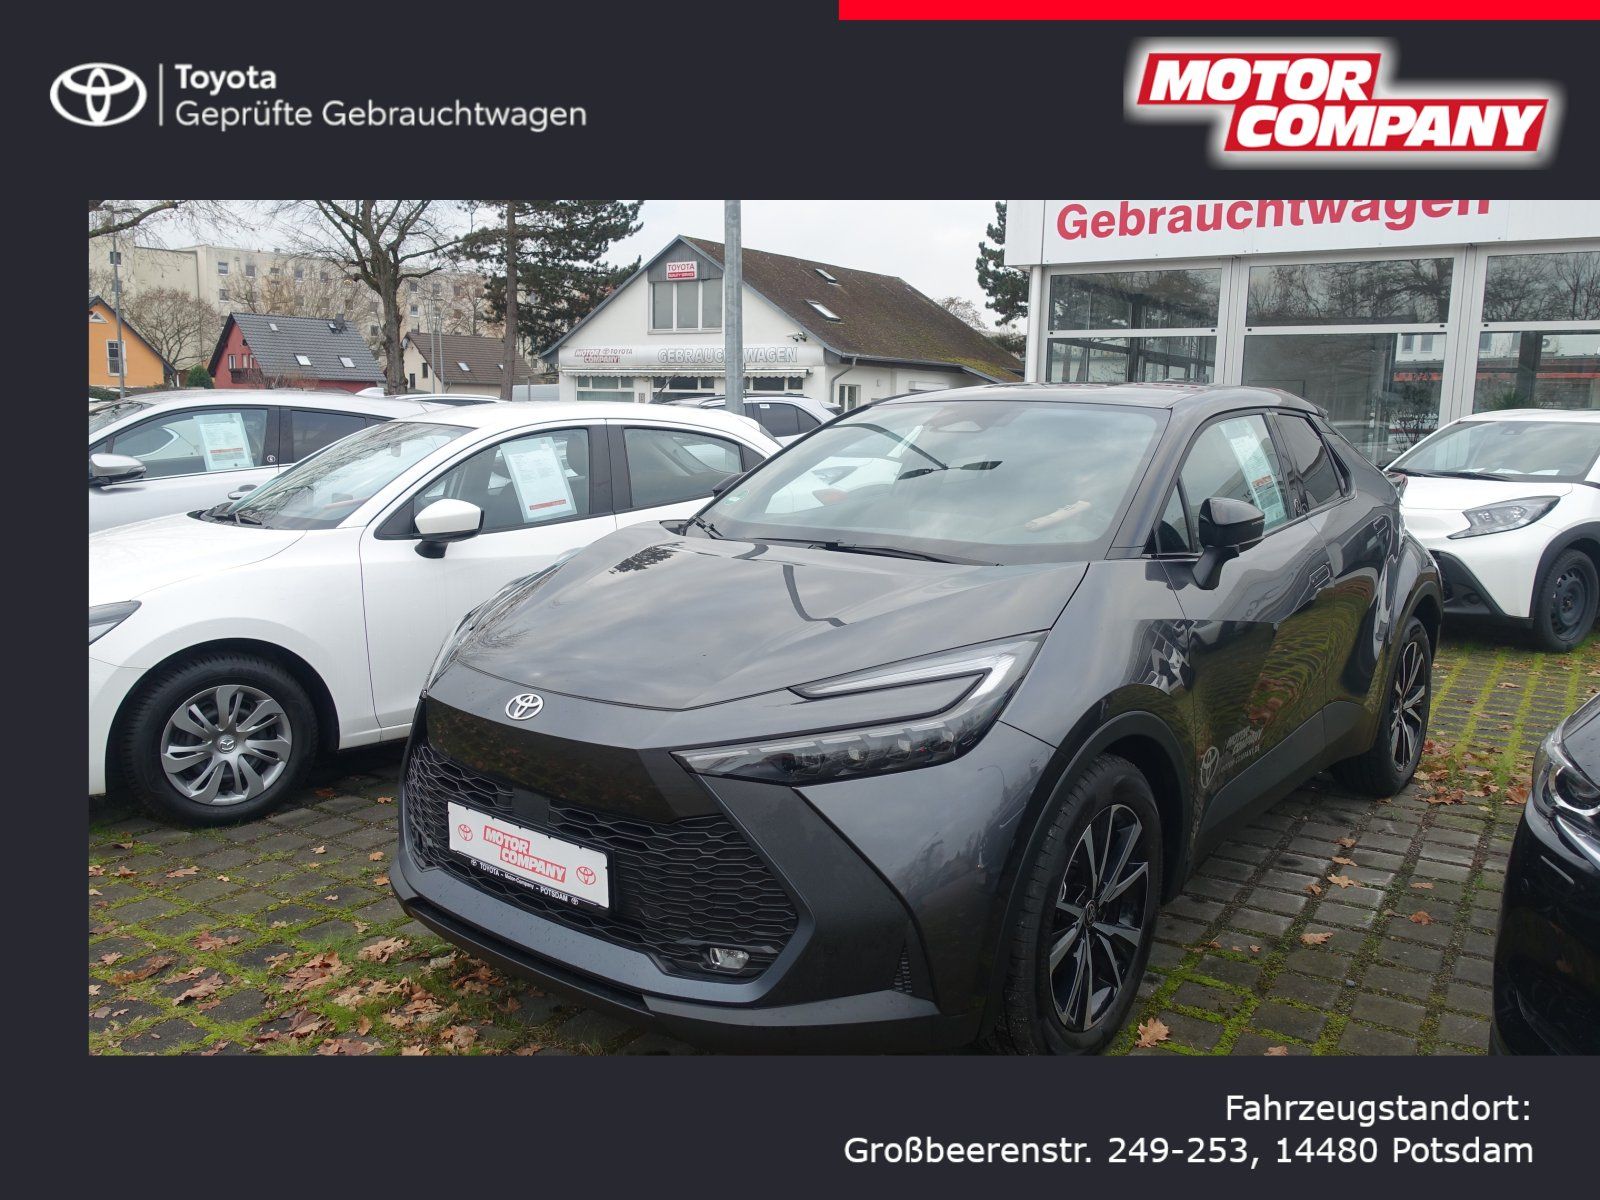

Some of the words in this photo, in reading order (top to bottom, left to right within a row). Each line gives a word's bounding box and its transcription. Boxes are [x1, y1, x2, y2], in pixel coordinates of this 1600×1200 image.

[668, 263, 695, 271] TOYOTA
[658, 346, 798, 363] GEBRAUCWAGEN
[485, 827, 529, 855] MOTOR
[501, 847, 566, 881] COMPANY
[480, 862, 500, 877] TOYOTA
[540, 886, 569, 903] POTSDAM
